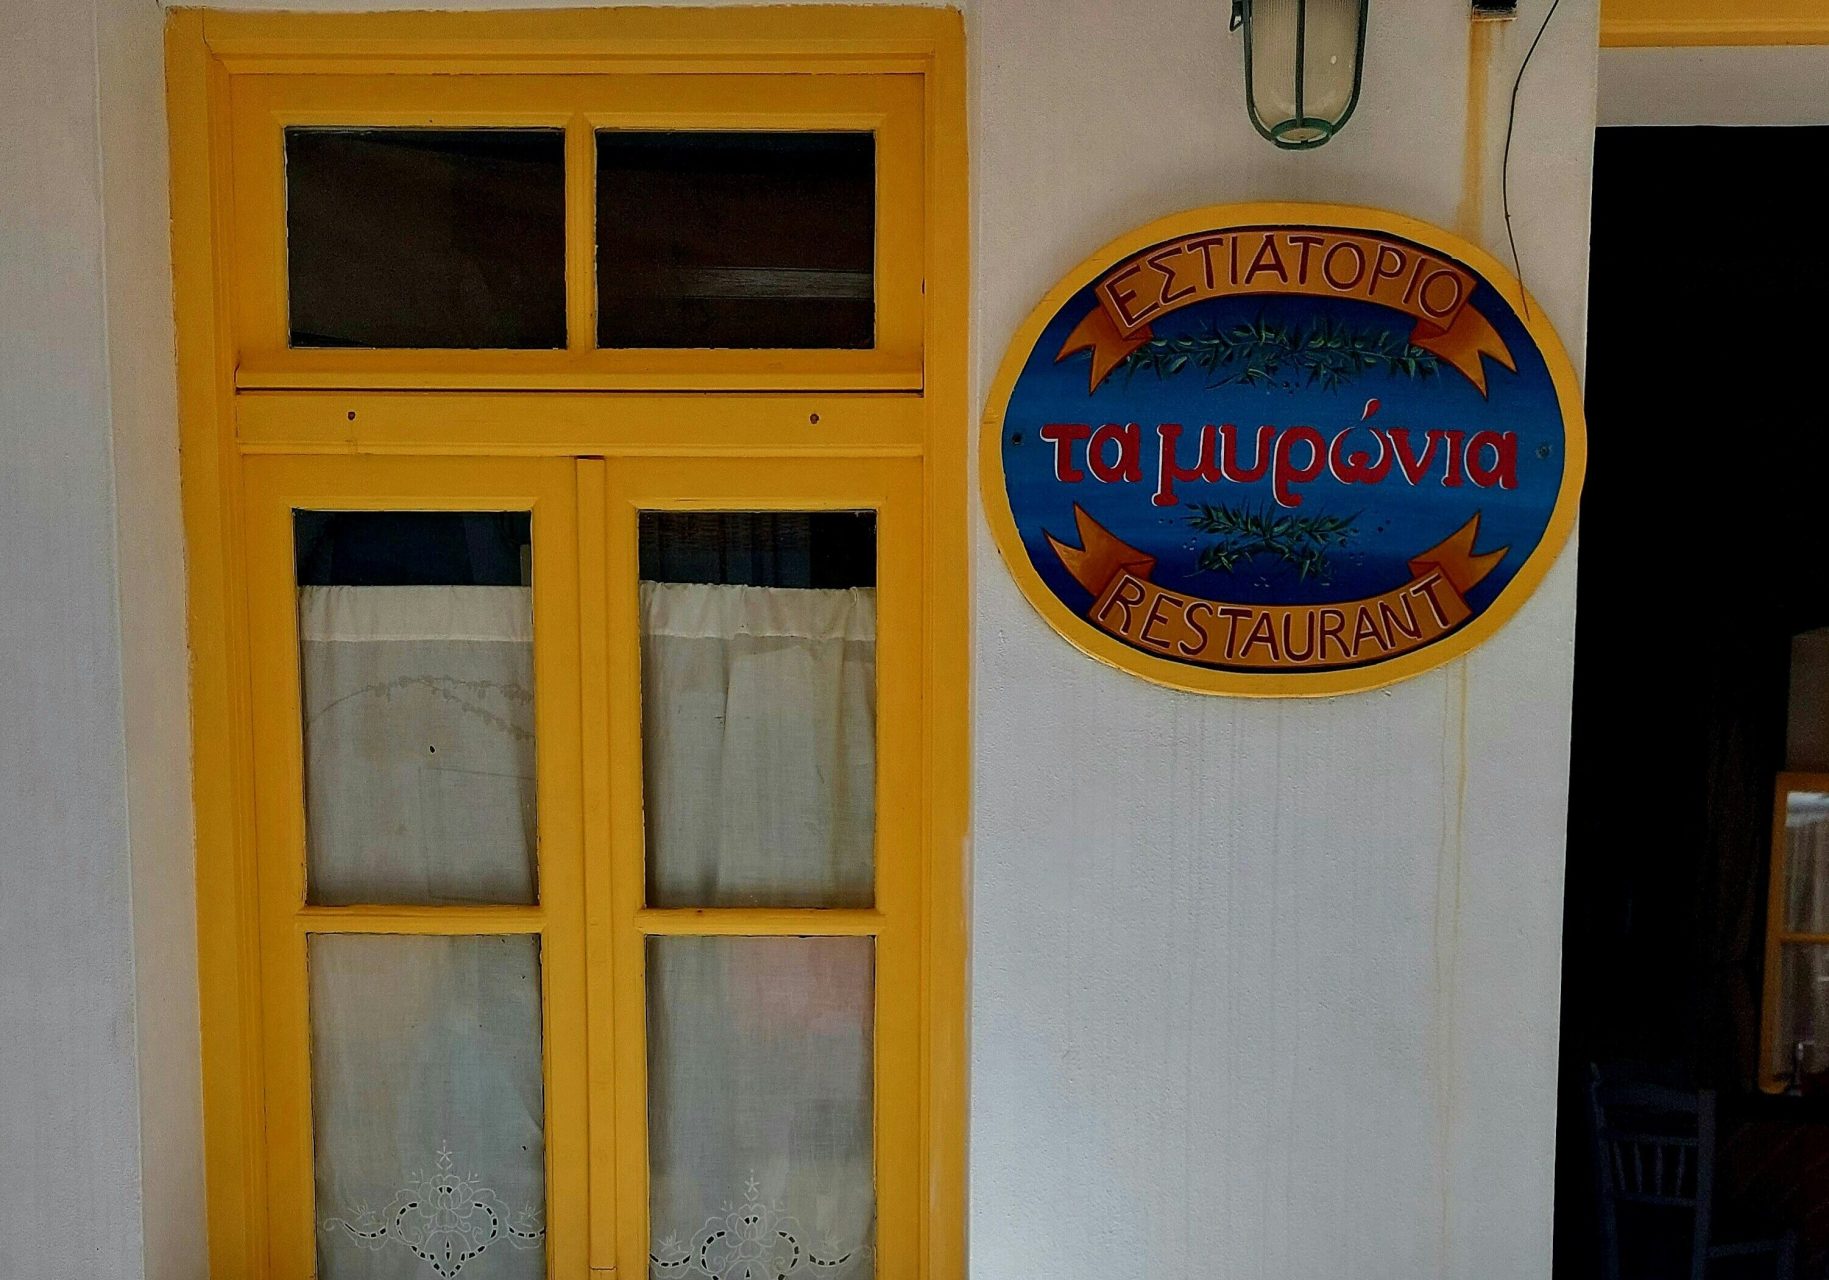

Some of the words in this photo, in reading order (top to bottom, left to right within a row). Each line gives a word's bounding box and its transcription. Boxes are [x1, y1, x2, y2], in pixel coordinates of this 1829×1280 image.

[1103, 233, 1464, 327] ΕΣΤΙΑΤΟΡΙΟ
[1039, 422, 1143, 484] τα
[1151, 398, 1519, 509] μυρώνια
[1097, 573, 1455, 662] RESTAURANT
